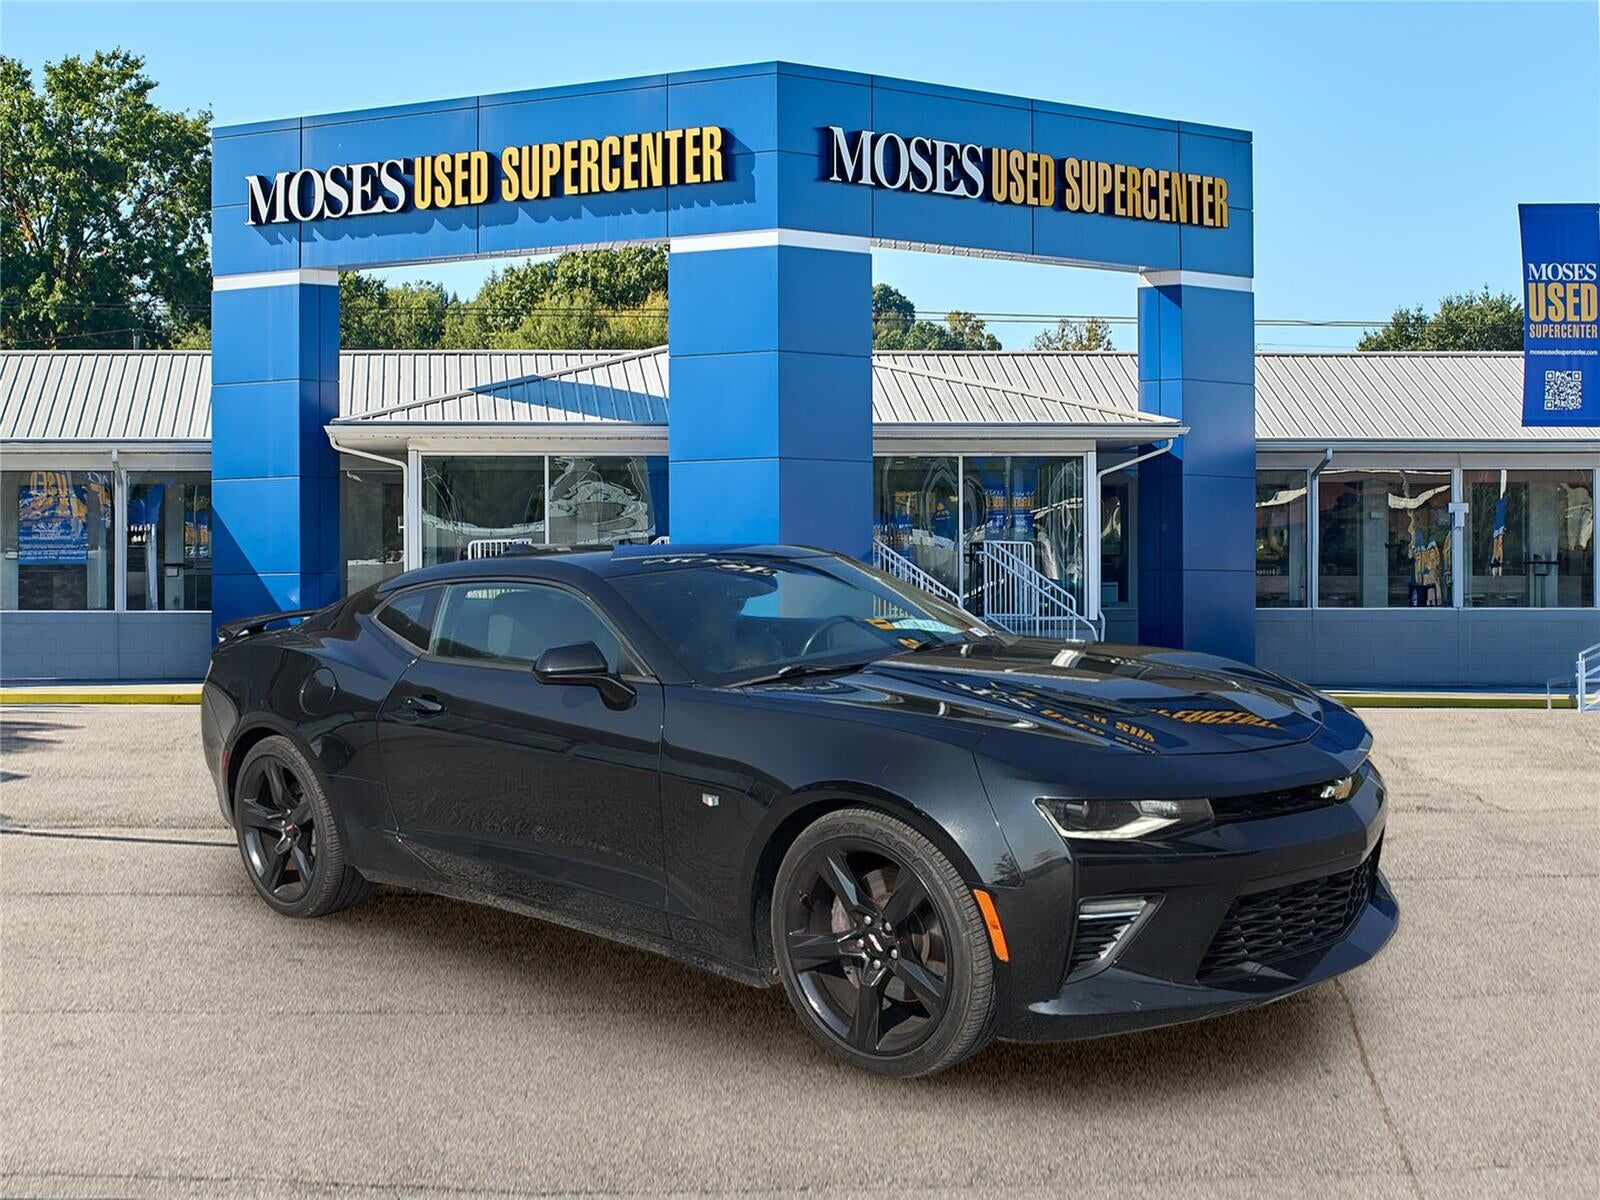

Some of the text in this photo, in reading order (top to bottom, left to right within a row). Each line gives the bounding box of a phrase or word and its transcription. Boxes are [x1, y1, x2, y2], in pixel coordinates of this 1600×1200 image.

[244, 126, 723, 226] MOSES USED SUPERCENTER
[829, 126, 1230, 228] MOSES USED SUPERCENTER
[1527, 263, 1597, 281] MOSES
[1528, 282, 1598, 323] USED
[1529, 323, 1598, 339] SUPERCENTER
